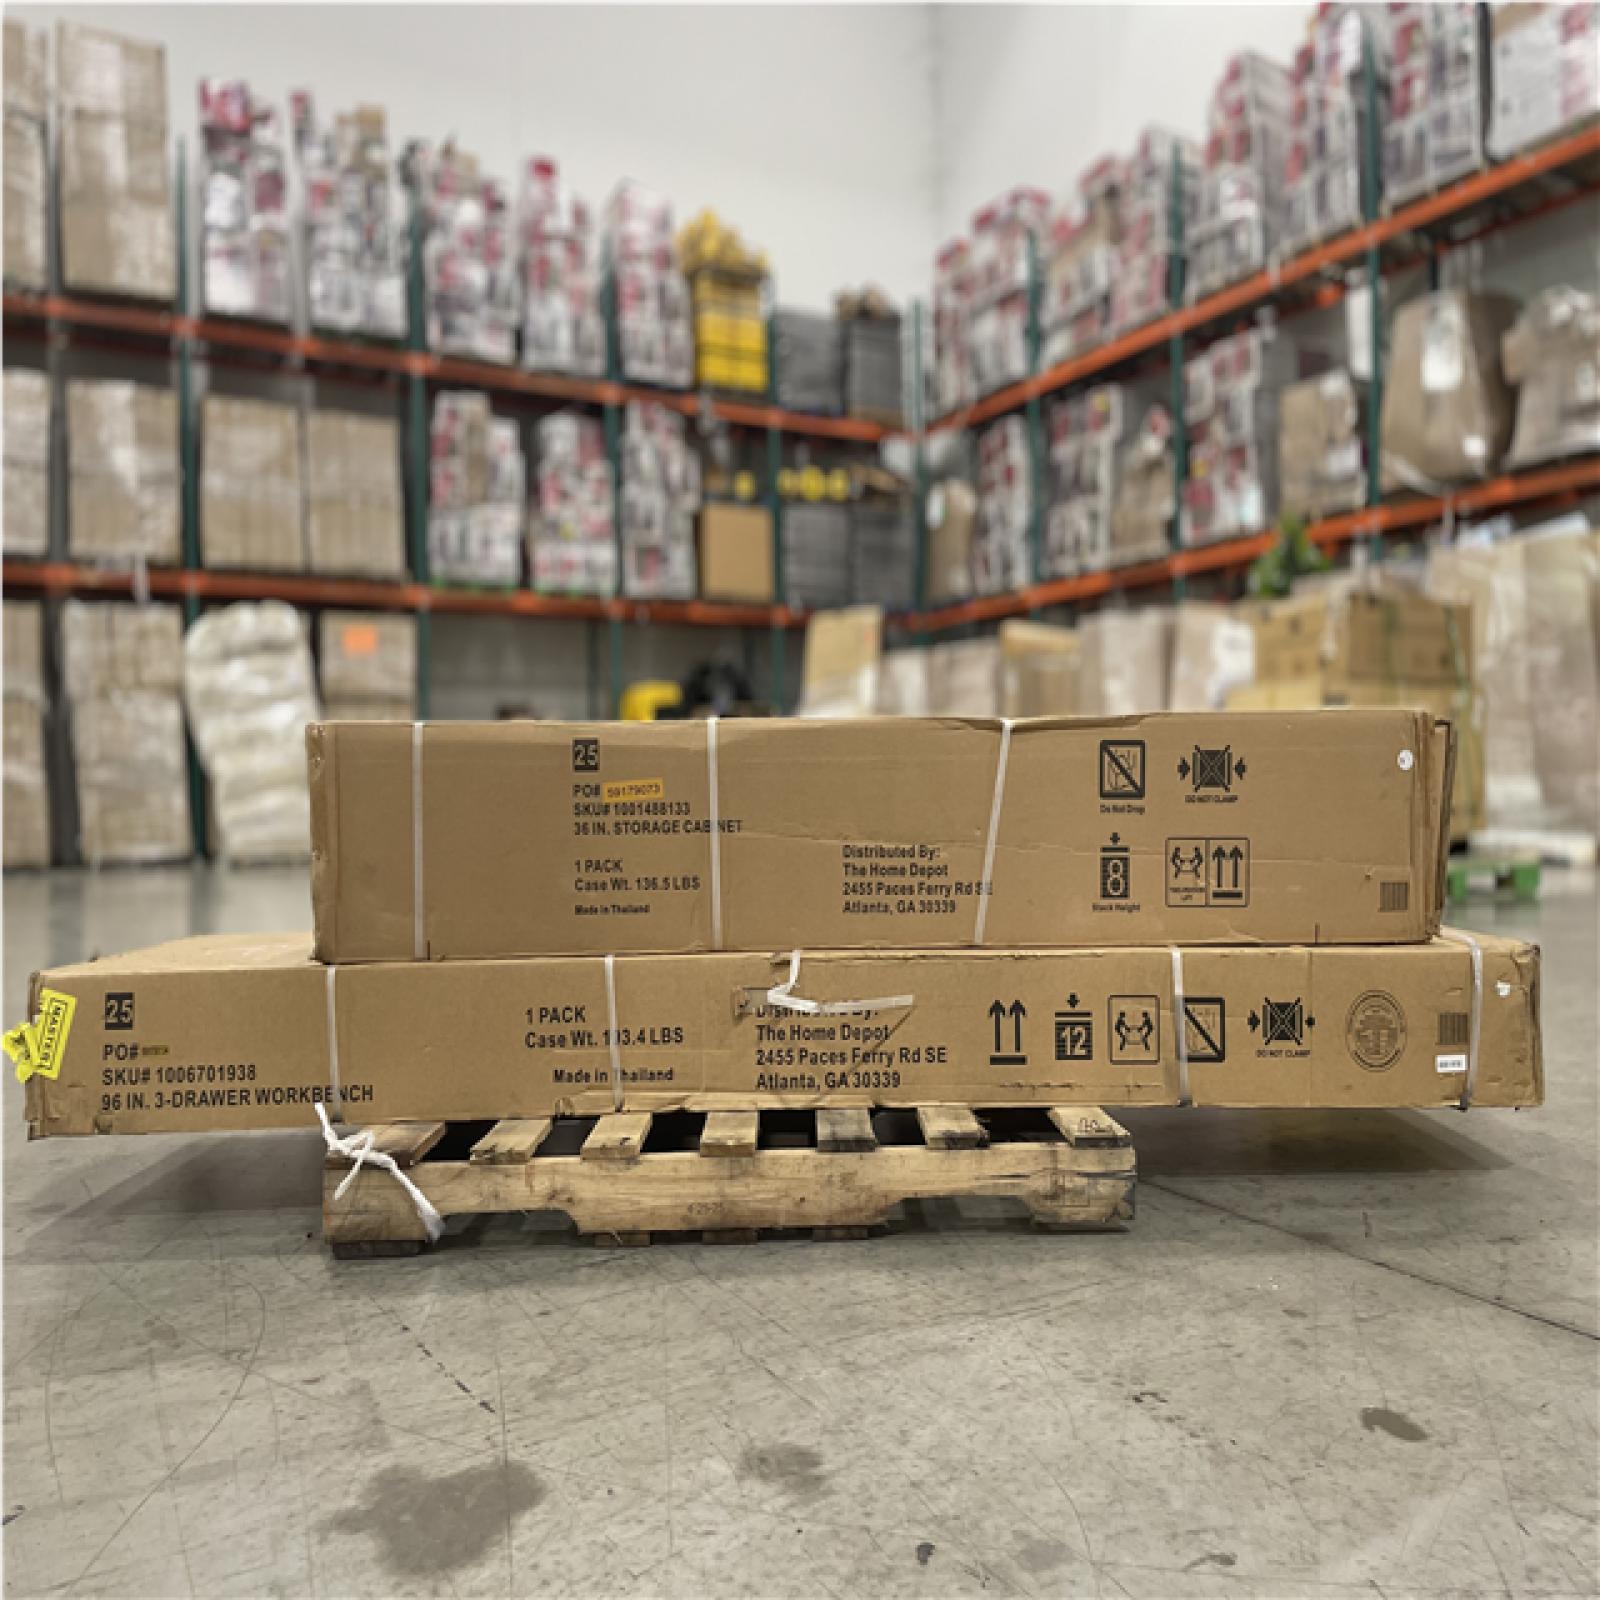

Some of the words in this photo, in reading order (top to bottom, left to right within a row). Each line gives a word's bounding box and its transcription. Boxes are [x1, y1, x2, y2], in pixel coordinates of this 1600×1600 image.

[573, 742, 599, 768] 25
[573, 784, 600, 798] PO#
[574, 802, 611, 816] SKU#
[574, 821, 590, 836] 36
[592, 821, 611, 835] IN.
[614, 820, 681, 835] STORAGE
[683, 819, 744, 834] CABNET
[842, 844, 915, 858] Distributed
[919, 845, 941, 860] By:
[574, 860, 581, 873] 1
[584, 859, 624, 873] PACK
[842, 863, 866, 877] The
[869, 863, 906, 877] Home
[909, 863, 949, 879] Depot
[574, 878, 608, 891] Case
[610, 877, 632, 891] Wt.
[673, 876, 700, 890] LBS
[842, 882, 873, 896] 2455
[876, 882, 915, 896] Paces
[917, 882, 951, 898] Ferry
[954, 881, 973, 896] Rd
[612, 903, 651, 915] Thailand
[842, 900, 893, 915] Atlanta,
[897, 900, 915, 913] GA
[919, 900, 956, 913] 30339
[105, 996, 133, 1026] 25
[525, 1008, 533, 1024] 1
[539, 1005, 586, 1023] PACK
[525, 1032, 566, 1048] Case
[570, 1030, 598, 1046] Wt.
[650, 1026, 684, 1044] LBS
[756, 1025, 785, 1040] The
[789, 1025, 836, 1041] Home
[840, 1024, 890, 1043] Depot
[1062, 1026, 1086, 1056] 12
[103, 1044, 139, 1061] PO#
[756, 1047, 793, 1065] 2455
[799, 1047, 848, 1065] Paces
[852, 1047, 896, 1067] Ferry
[899, 1047, 921, 1063] Rd
[925, 1047, 948, 1063] SE
[102, 1066, 150, 1085] SKU#
[157, 1065, 257, 1083] 1006701938
[554, 1069, 591, 1083] Made
[757, 1072, 821, 1091] Atlanta,
[824, 1072, 849, 1089] GA
[853, 1071, 901, 1089] 30339
[102, 1092, 121, 1111] 96
[127, 1091, 150, 1110] IN.
[155, 1088, 251, 1109] 3-DRAWER
